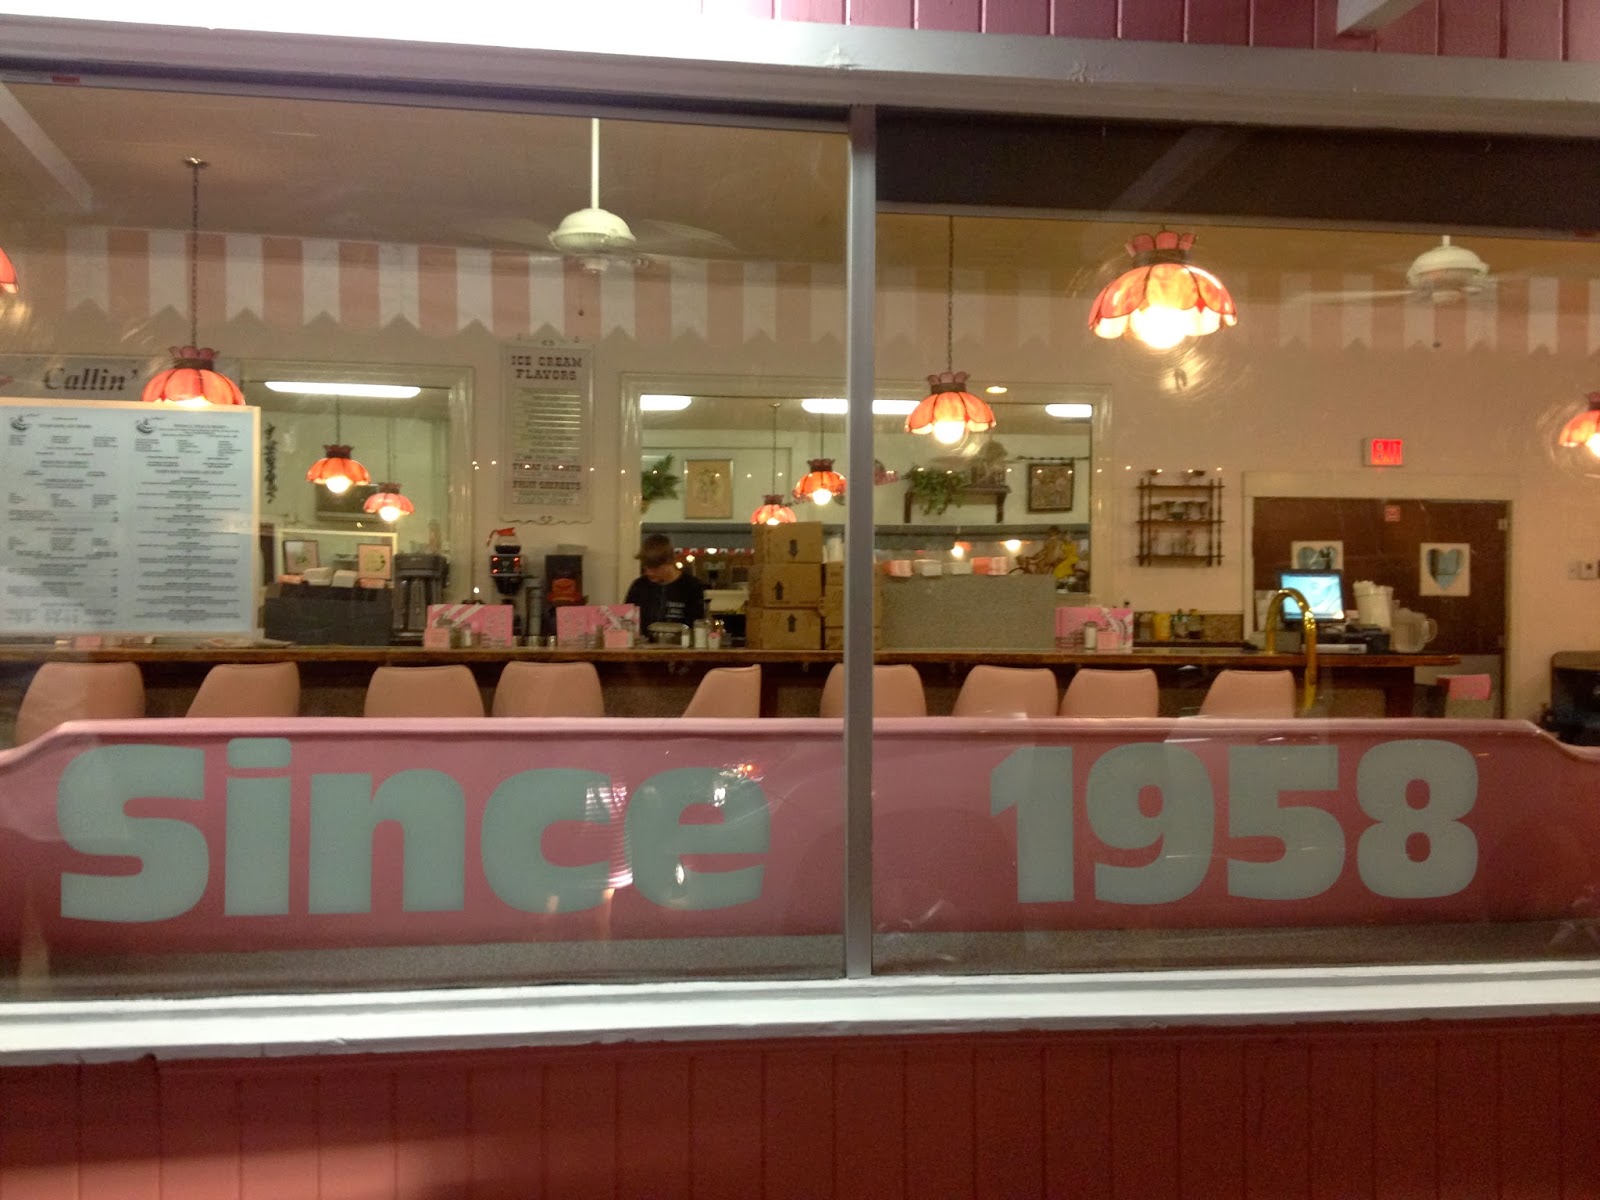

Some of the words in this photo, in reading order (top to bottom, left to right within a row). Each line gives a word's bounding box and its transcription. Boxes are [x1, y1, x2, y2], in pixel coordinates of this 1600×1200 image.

[511, 355, 532, 366] ICE
[538, 356, 583, 368] CREAM
[515, 368, 577, 381] FLAVORS
[57, 738, 770, 922] Since
[990, 739, 1479, 905] 1958
